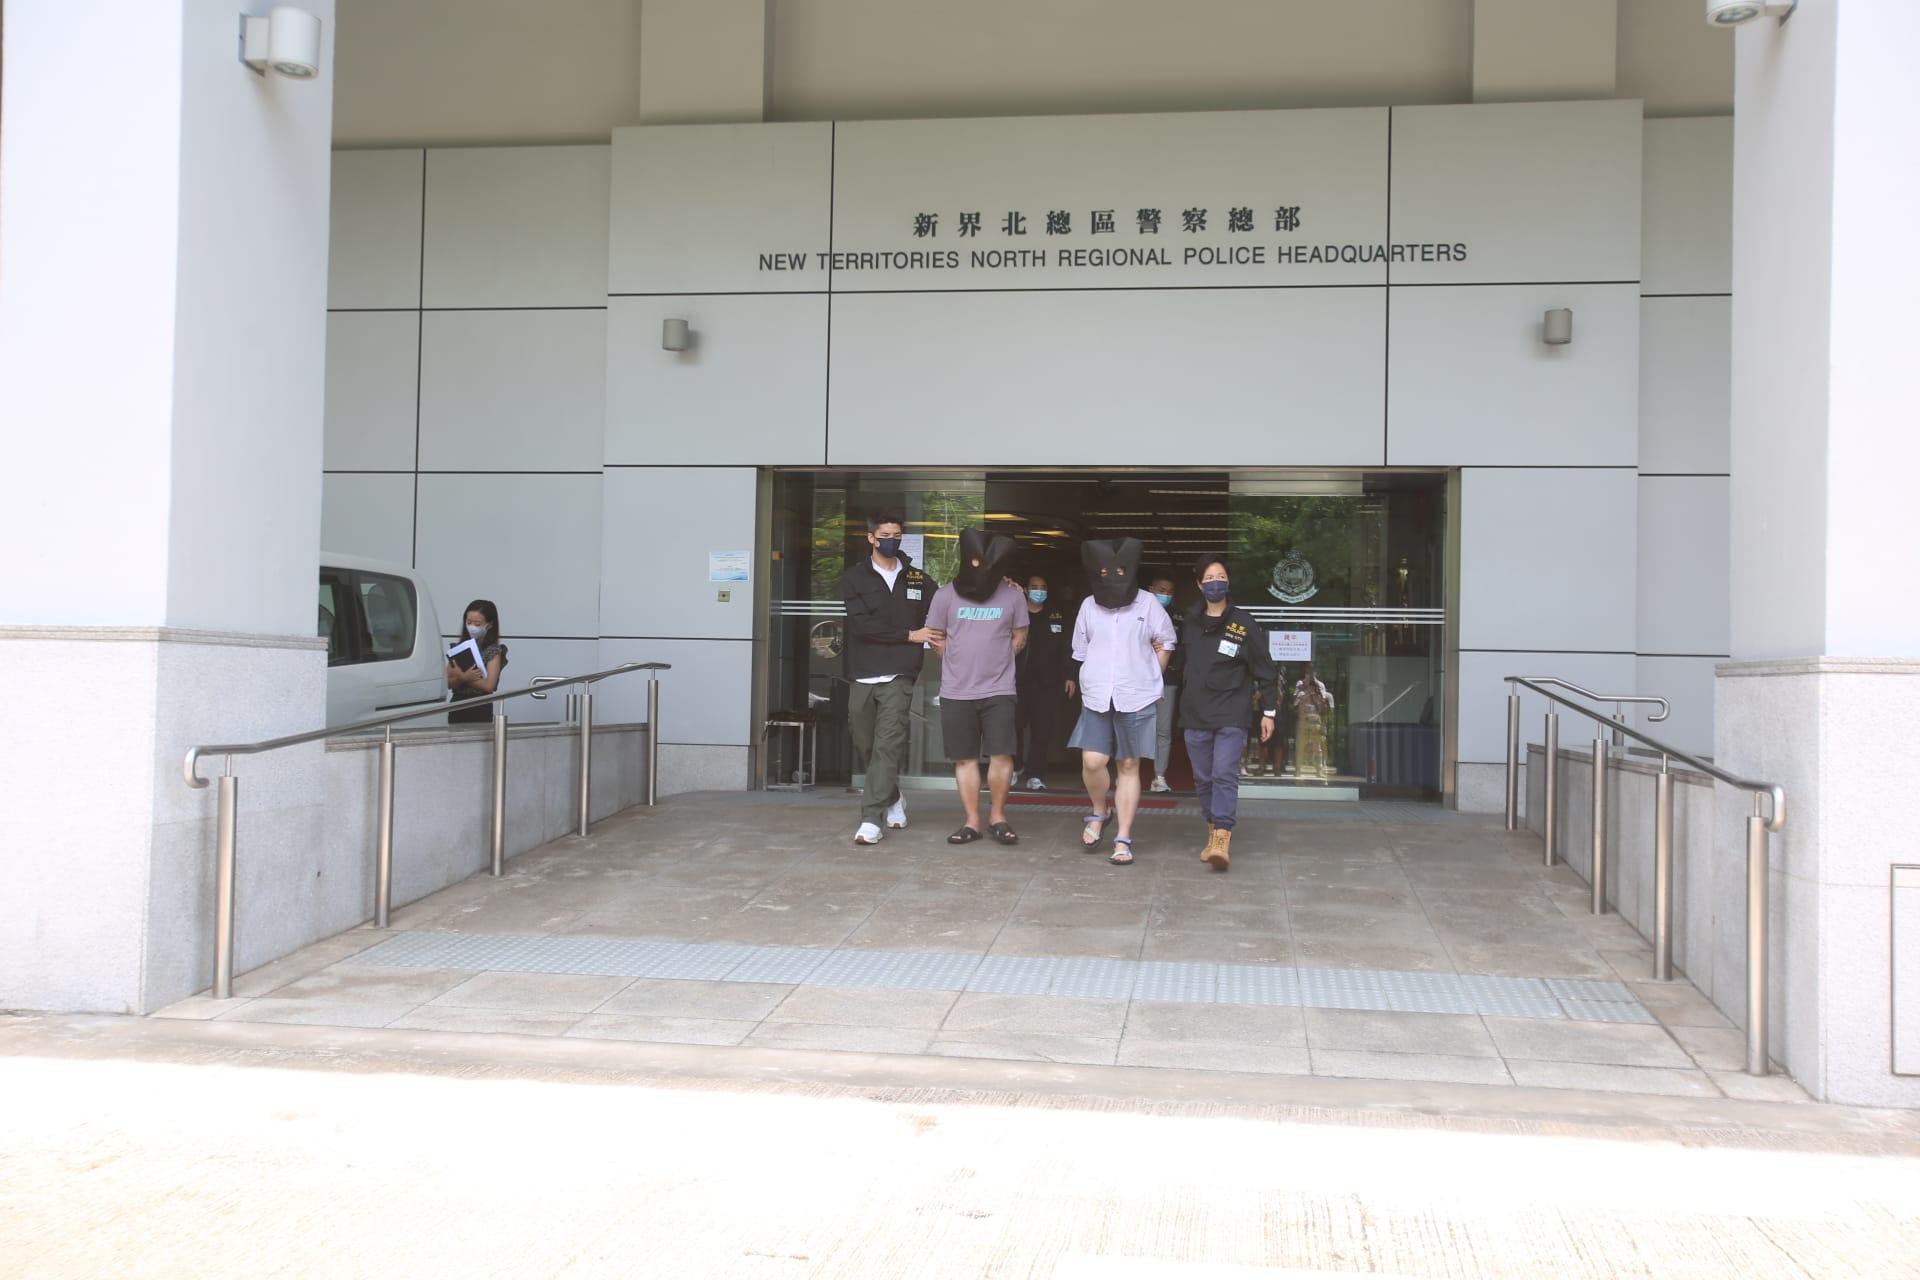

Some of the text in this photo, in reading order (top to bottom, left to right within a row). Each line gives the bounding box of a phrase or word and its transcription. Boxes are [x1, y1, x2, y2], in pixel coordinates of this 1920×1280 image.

[913, 205, 1301, 239] 新界北總區警察總部
[759, 242, 1468, 272] NEW TERRITORIES NORTH REGIONAL POLICE HEADQUARTERS
[957, 606, 1004, 621] CAUTION
